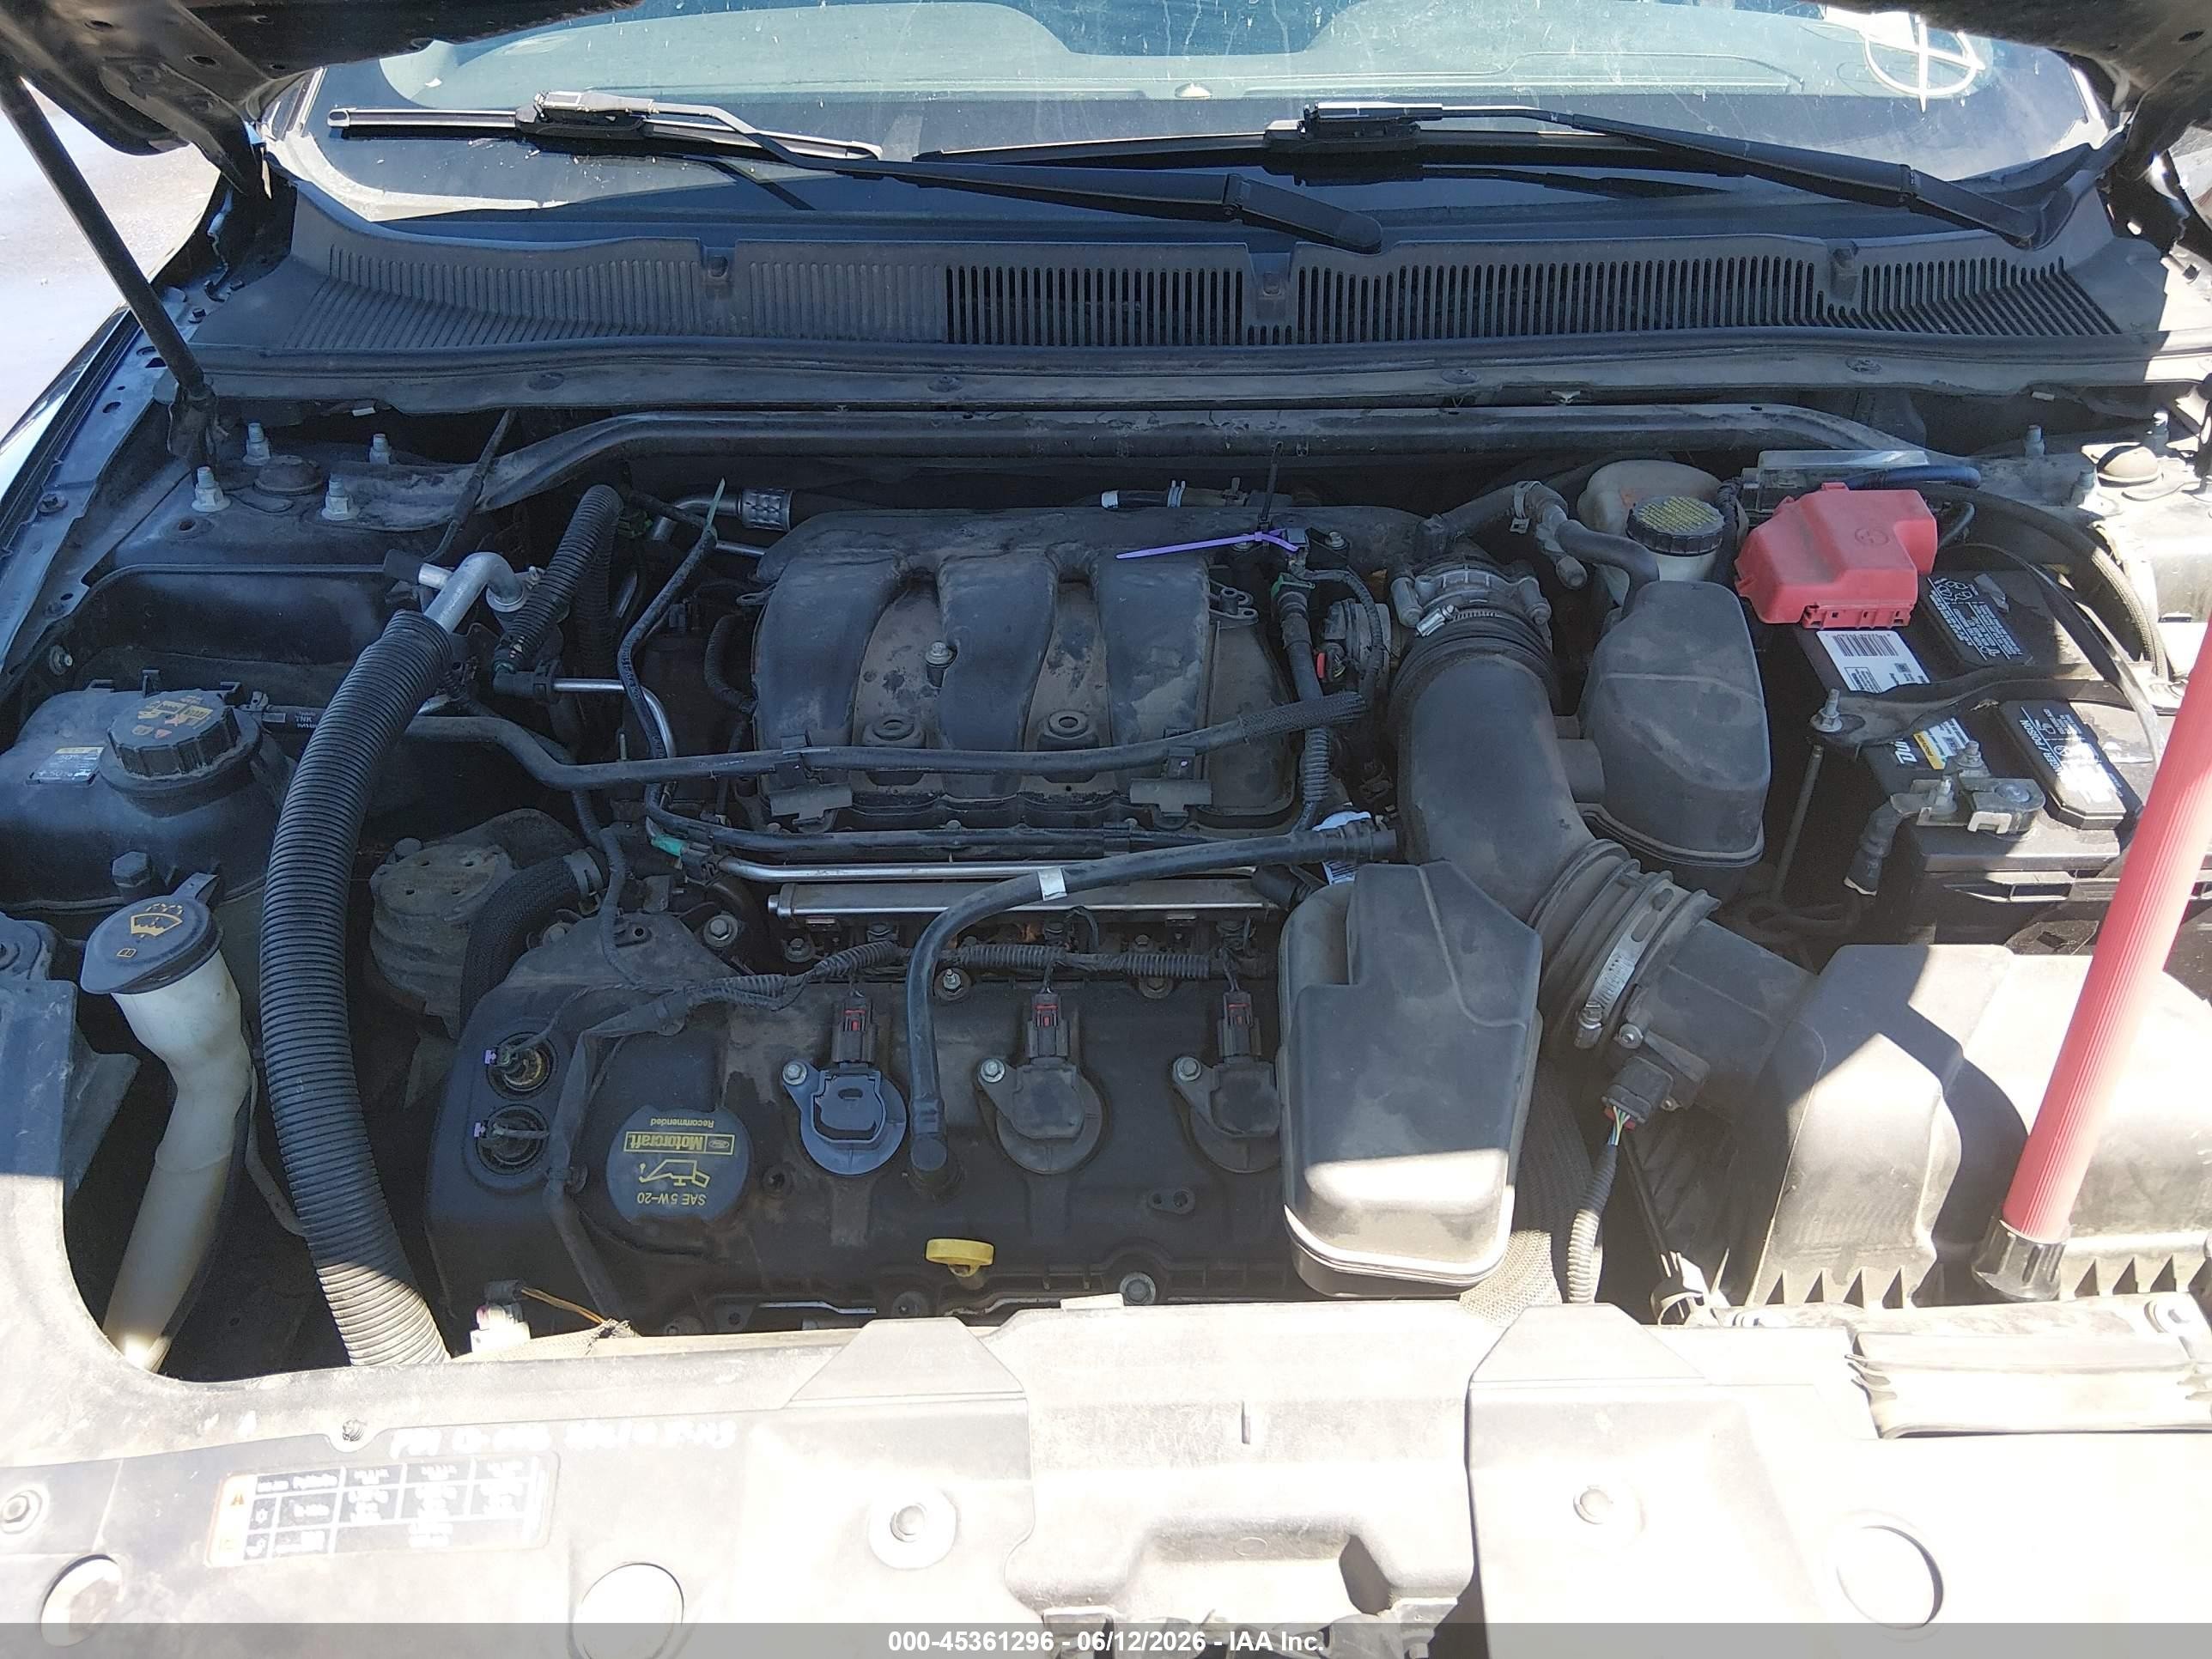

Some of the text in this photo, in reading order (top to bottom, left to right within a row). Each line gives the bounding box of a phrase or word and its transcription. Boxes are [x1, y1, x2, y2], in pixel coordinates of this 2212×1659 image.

[2019, 720, 2045, 746] POISON
[650, 1117, 714, 1128] Recommended
[629, 1133, 704, 1151] Motorcraft
[636, 1192, 708, 1206] SAE 5W-20
